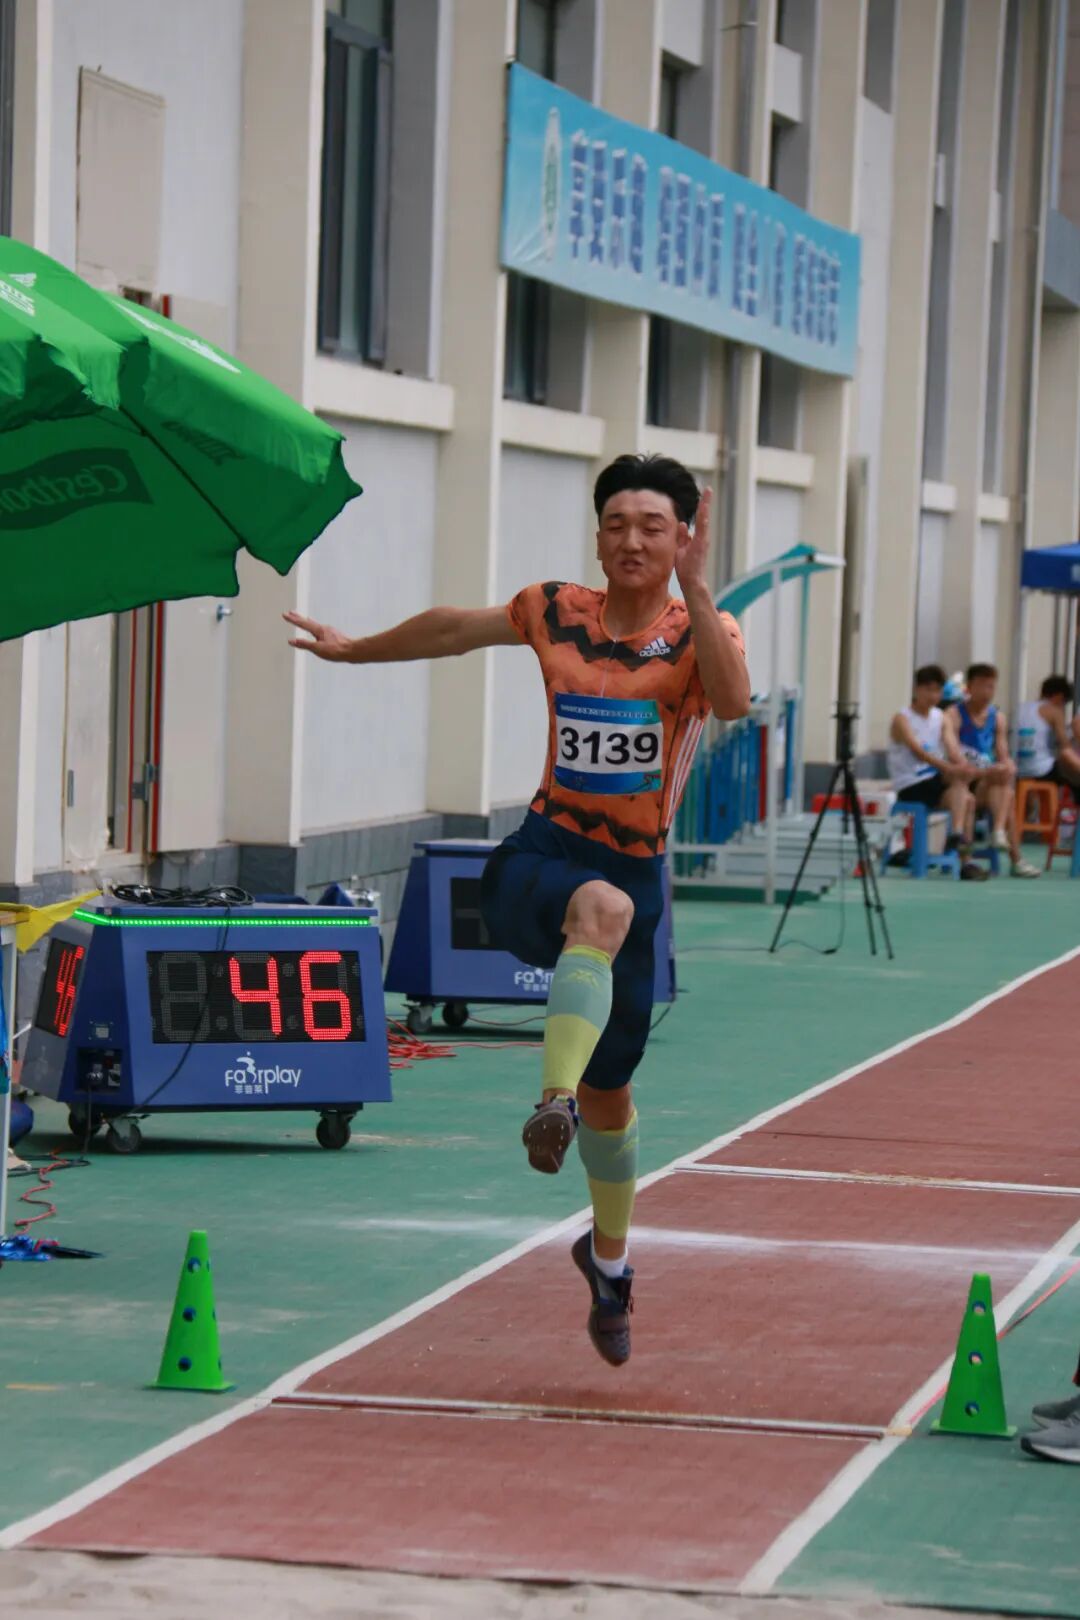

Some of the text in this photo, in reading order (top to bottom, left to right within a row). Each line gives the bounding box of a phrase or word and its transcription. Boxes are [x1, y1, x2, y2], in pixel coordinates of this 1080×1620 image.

[639, 646, 671, 657] adidas
[560, 726, 659, 765] 3139
[229, 950, 352, 1040] 46
[224, 1051, 302, 1095] fairplay
